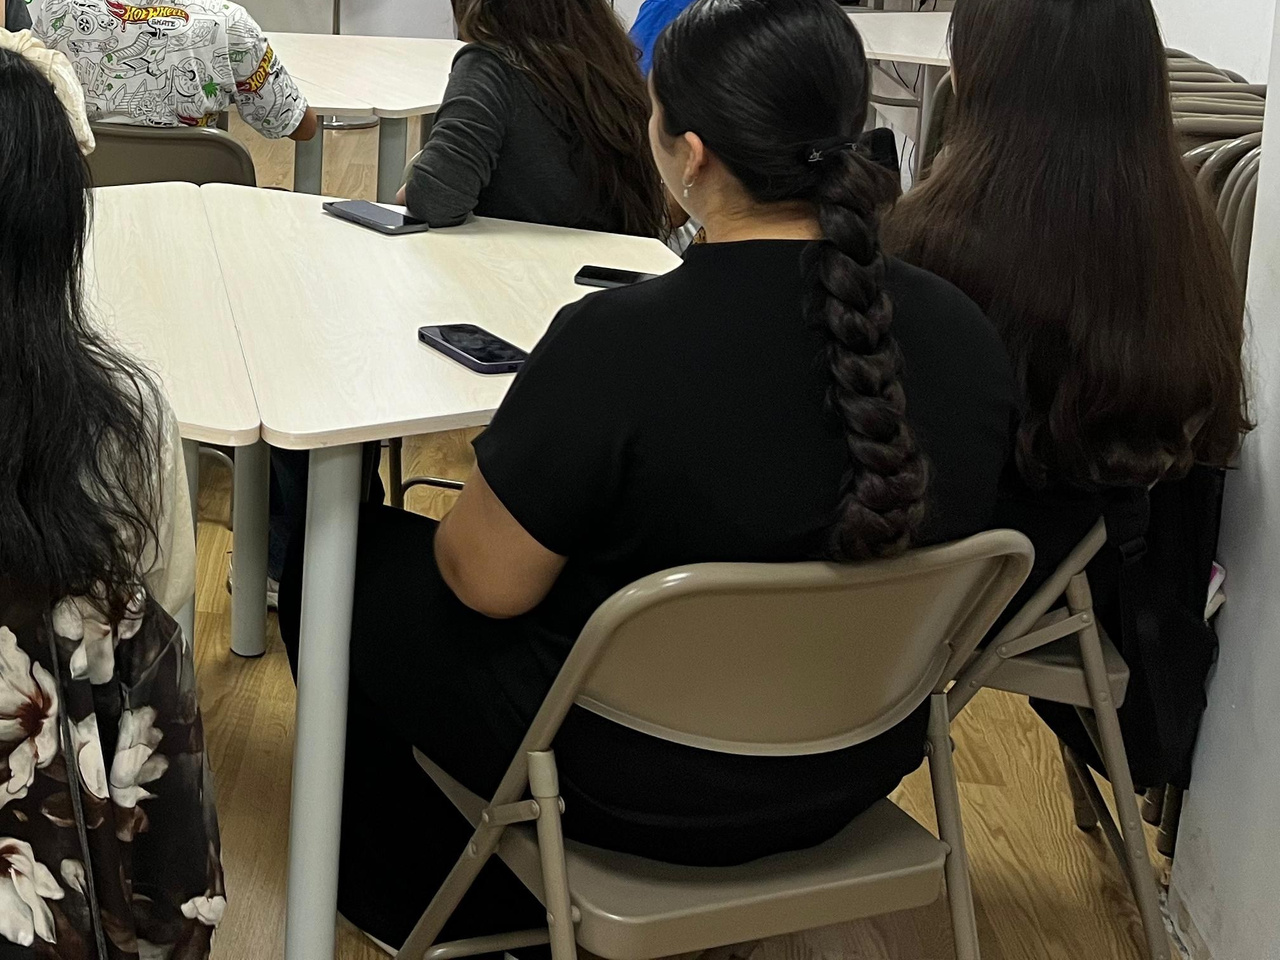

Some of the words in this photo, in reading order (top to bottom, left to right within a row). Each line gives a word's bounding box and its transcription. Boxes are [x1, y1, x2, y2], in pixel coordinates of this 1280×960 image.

[124, 6, 148, 21] HOT
[147, 6, 186, 19] WHEELS
[151, 19, 176, 27] SKATE
